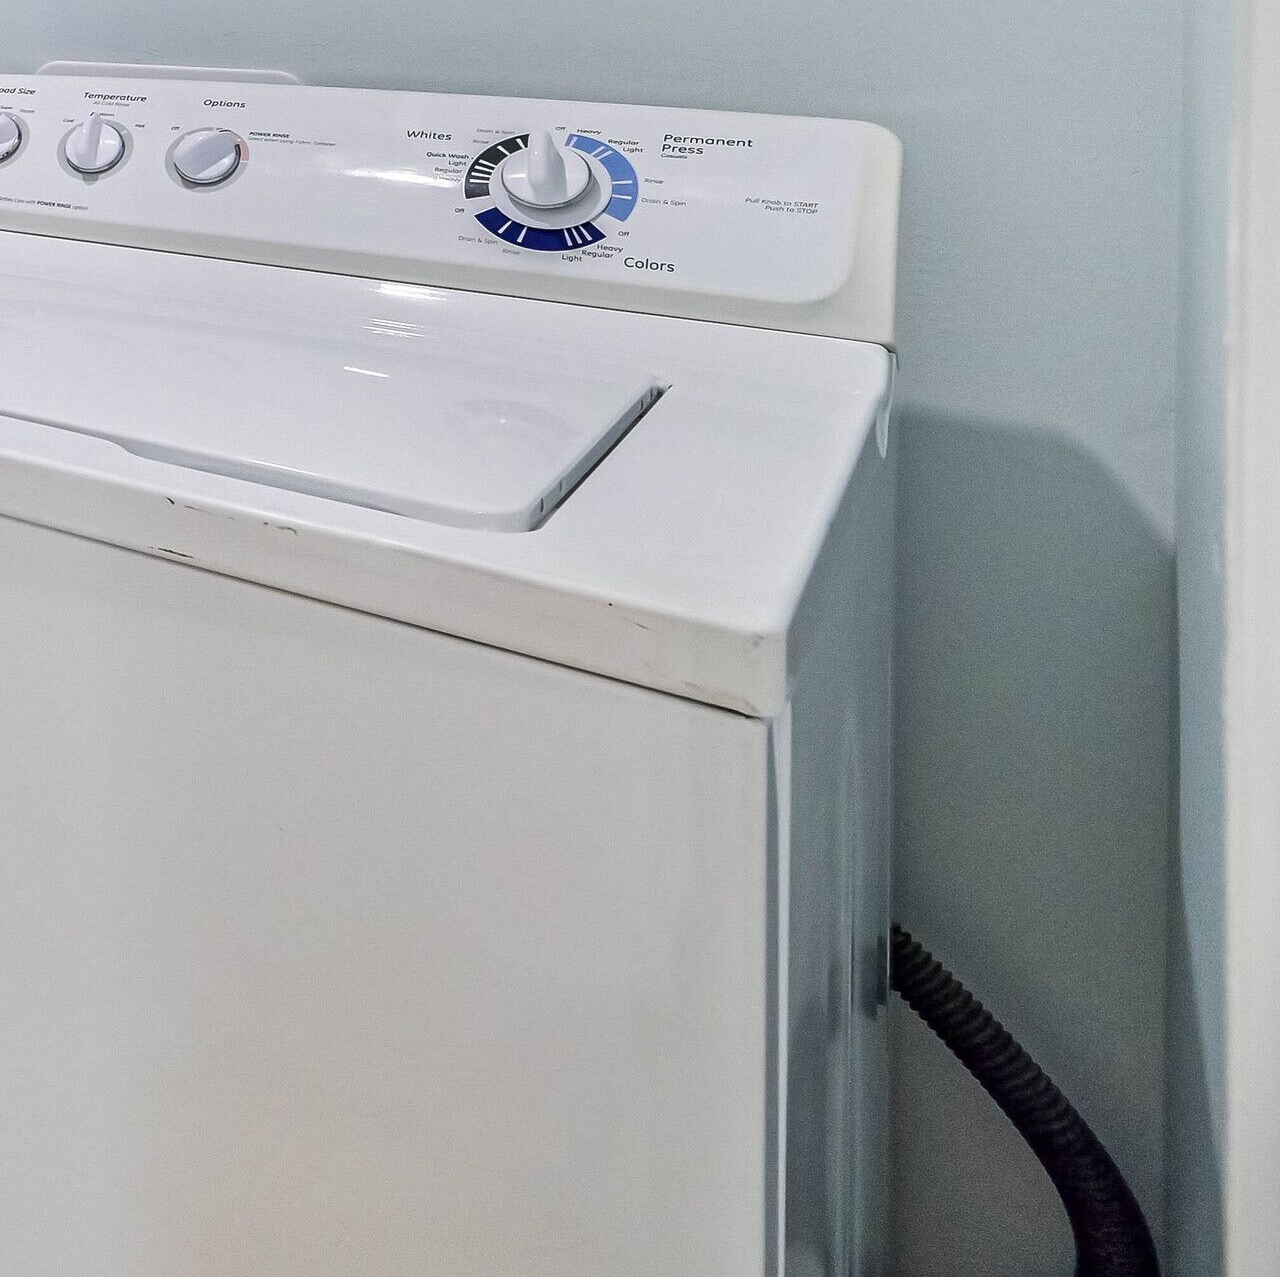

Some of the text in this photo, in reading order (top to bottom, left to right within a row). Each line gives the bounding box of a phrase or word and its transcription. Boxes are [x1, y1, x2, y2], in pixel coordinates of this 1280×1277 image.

[17, 87, 36, 95] Size
[84, 91, 148, 103] Temperature
[203, 99, 246, 109] Options
[406, 129, 452, 141] Whites
[576, 128, 602, 136] Heavy
[608, 138, 640, 147] Regular
[663, 133, 753, 148] Permanent
[662, 143, 704, 155] Press
[641, 197, 661, 205] Drain
[670, 200, 687, 208] Spin
[793, 201, 819, 209] START
[597, 244, 624, 254] Heavy
[561, 254, 583, 263] Light
[581, 249, 614, 260] Regular
[624, 256, 675, 273] Colors
